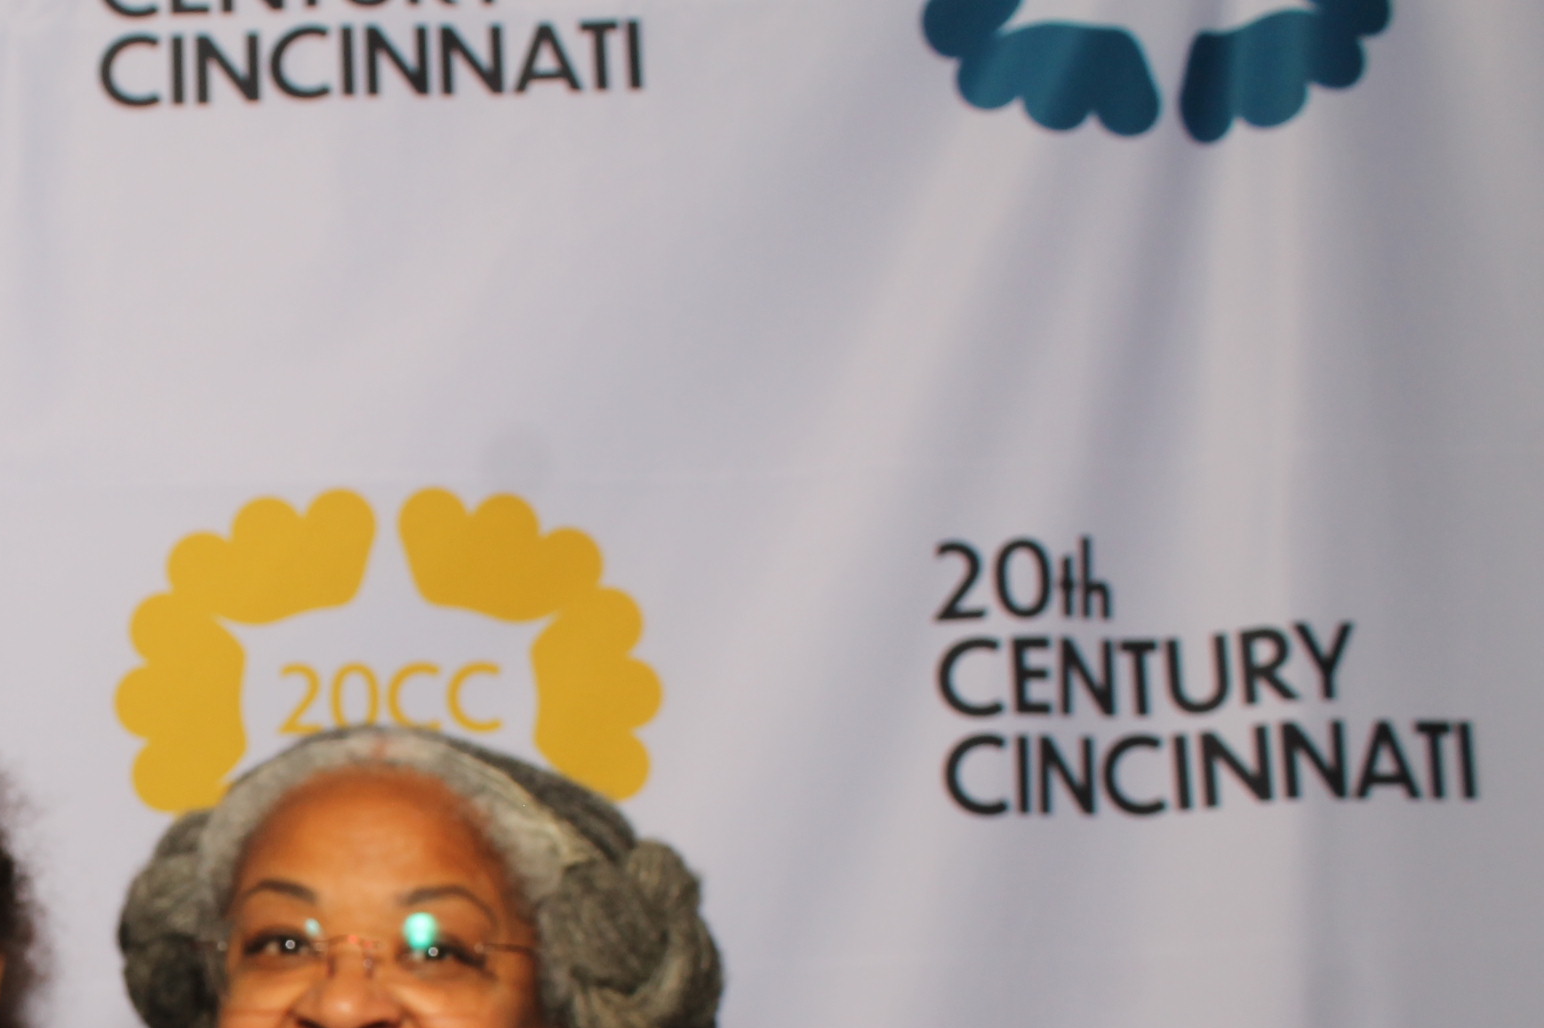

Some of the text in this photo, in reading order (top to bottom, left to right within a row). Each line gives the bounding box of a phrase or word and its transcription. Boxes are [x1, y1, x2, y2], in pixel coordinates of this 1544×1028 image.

[98, 20, 644, 107] CINCINNATI
[934, 536, 1113, 622] 20th
[277, 661, 503, 735] 20CC
[936, 622, 1354, 716] CENTURY
[943, 719, 1480, 817] CINCINNATI
